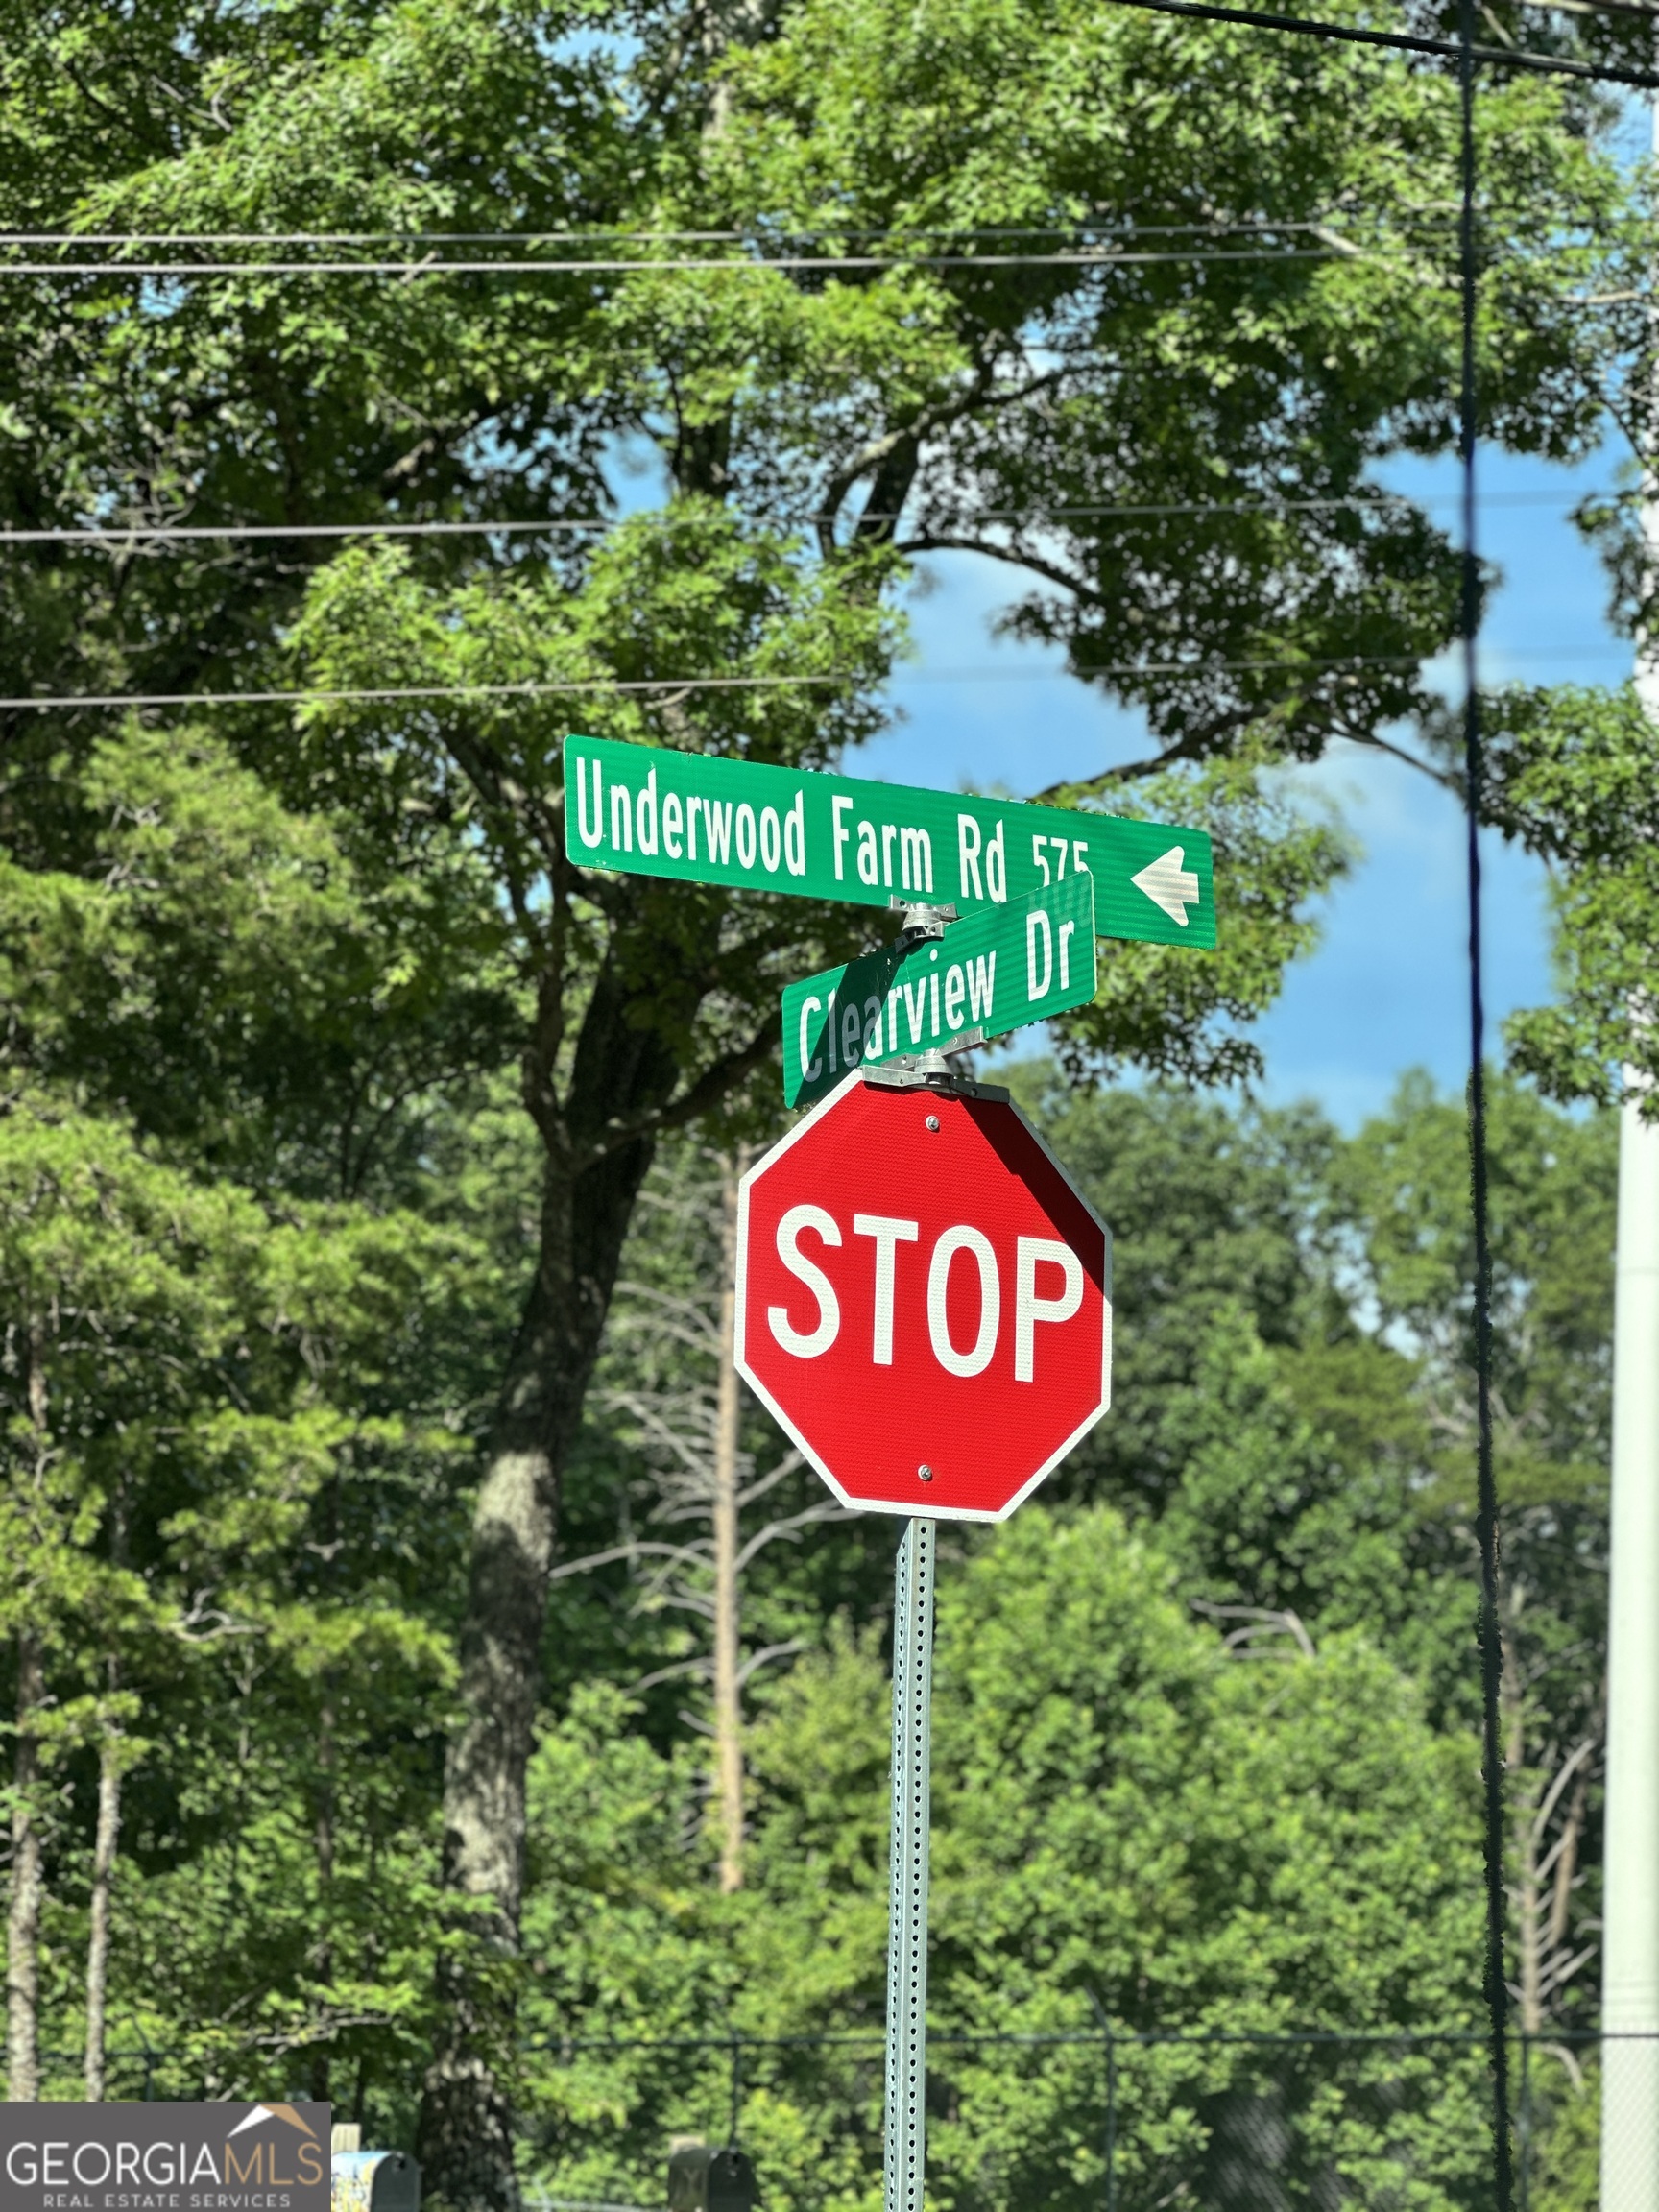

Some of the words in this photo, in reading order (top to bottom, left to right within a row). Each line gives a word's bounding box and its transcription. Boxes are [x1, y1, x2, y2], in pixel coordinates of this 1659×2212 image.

[576, 756, 805, 877] Underwood
[831, 794, 934, 894] Farm
[957, 813, 1008, 903] Rd
[799, 949, 997, 1083] Clearview
[1026, 909, 1075, 1002] Dr
[767, 1204, 1084, 1382] STOP
